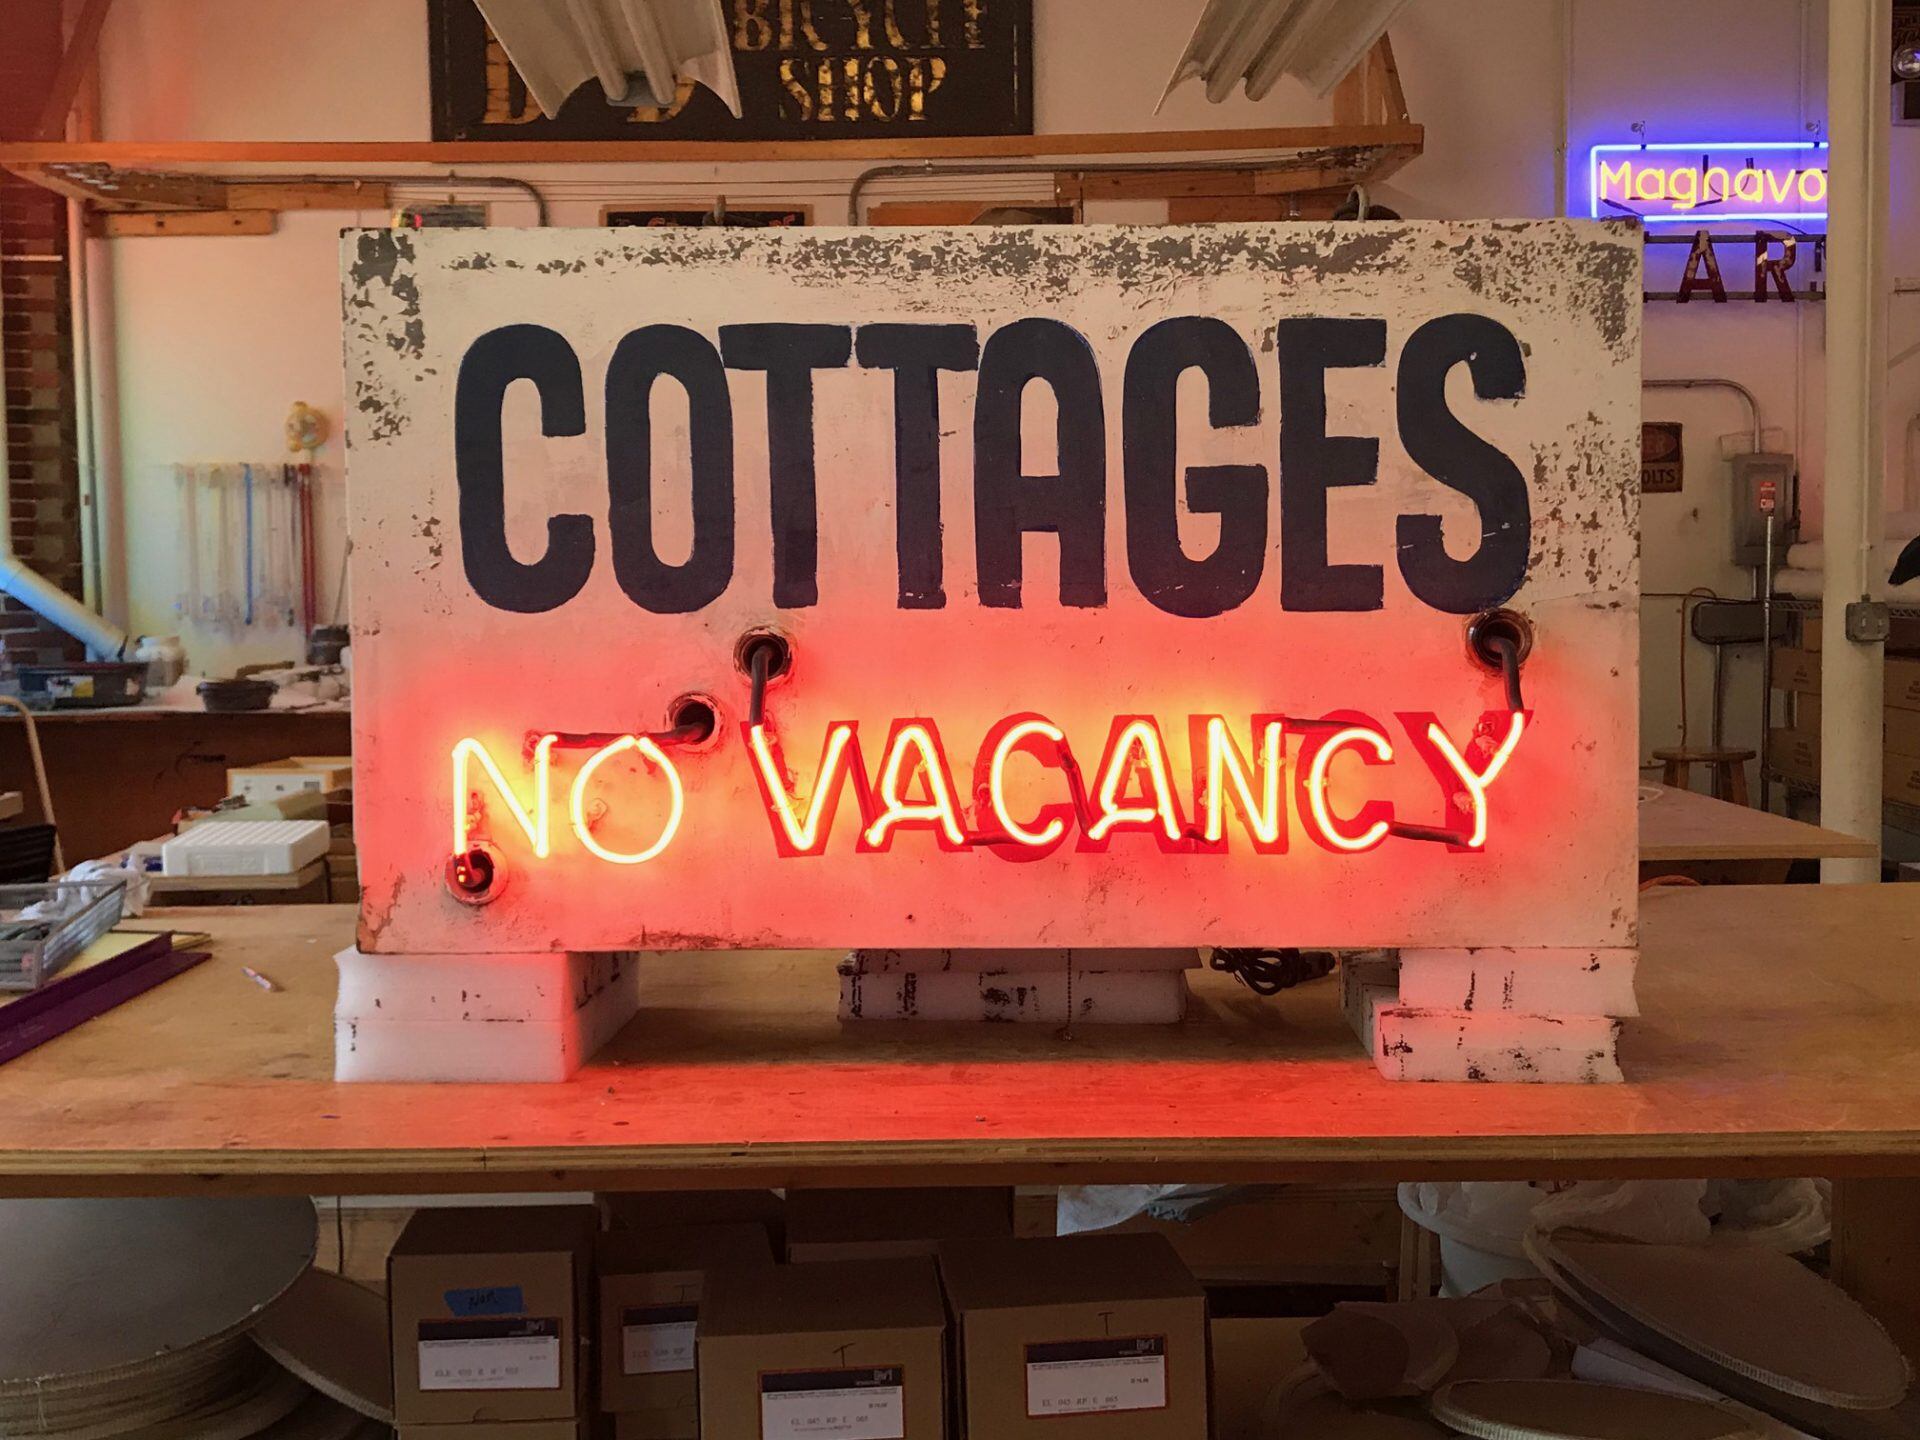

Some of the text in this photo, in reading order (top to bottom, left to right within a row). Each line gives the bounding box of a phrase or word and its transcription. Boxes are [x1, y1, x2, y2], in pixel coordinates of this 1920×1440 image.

[780, 56, 947, 121] SHOP
[455, 314, 1531, 617] COTTAGES
[453, 709, 1534, 864] NO VACANCY
